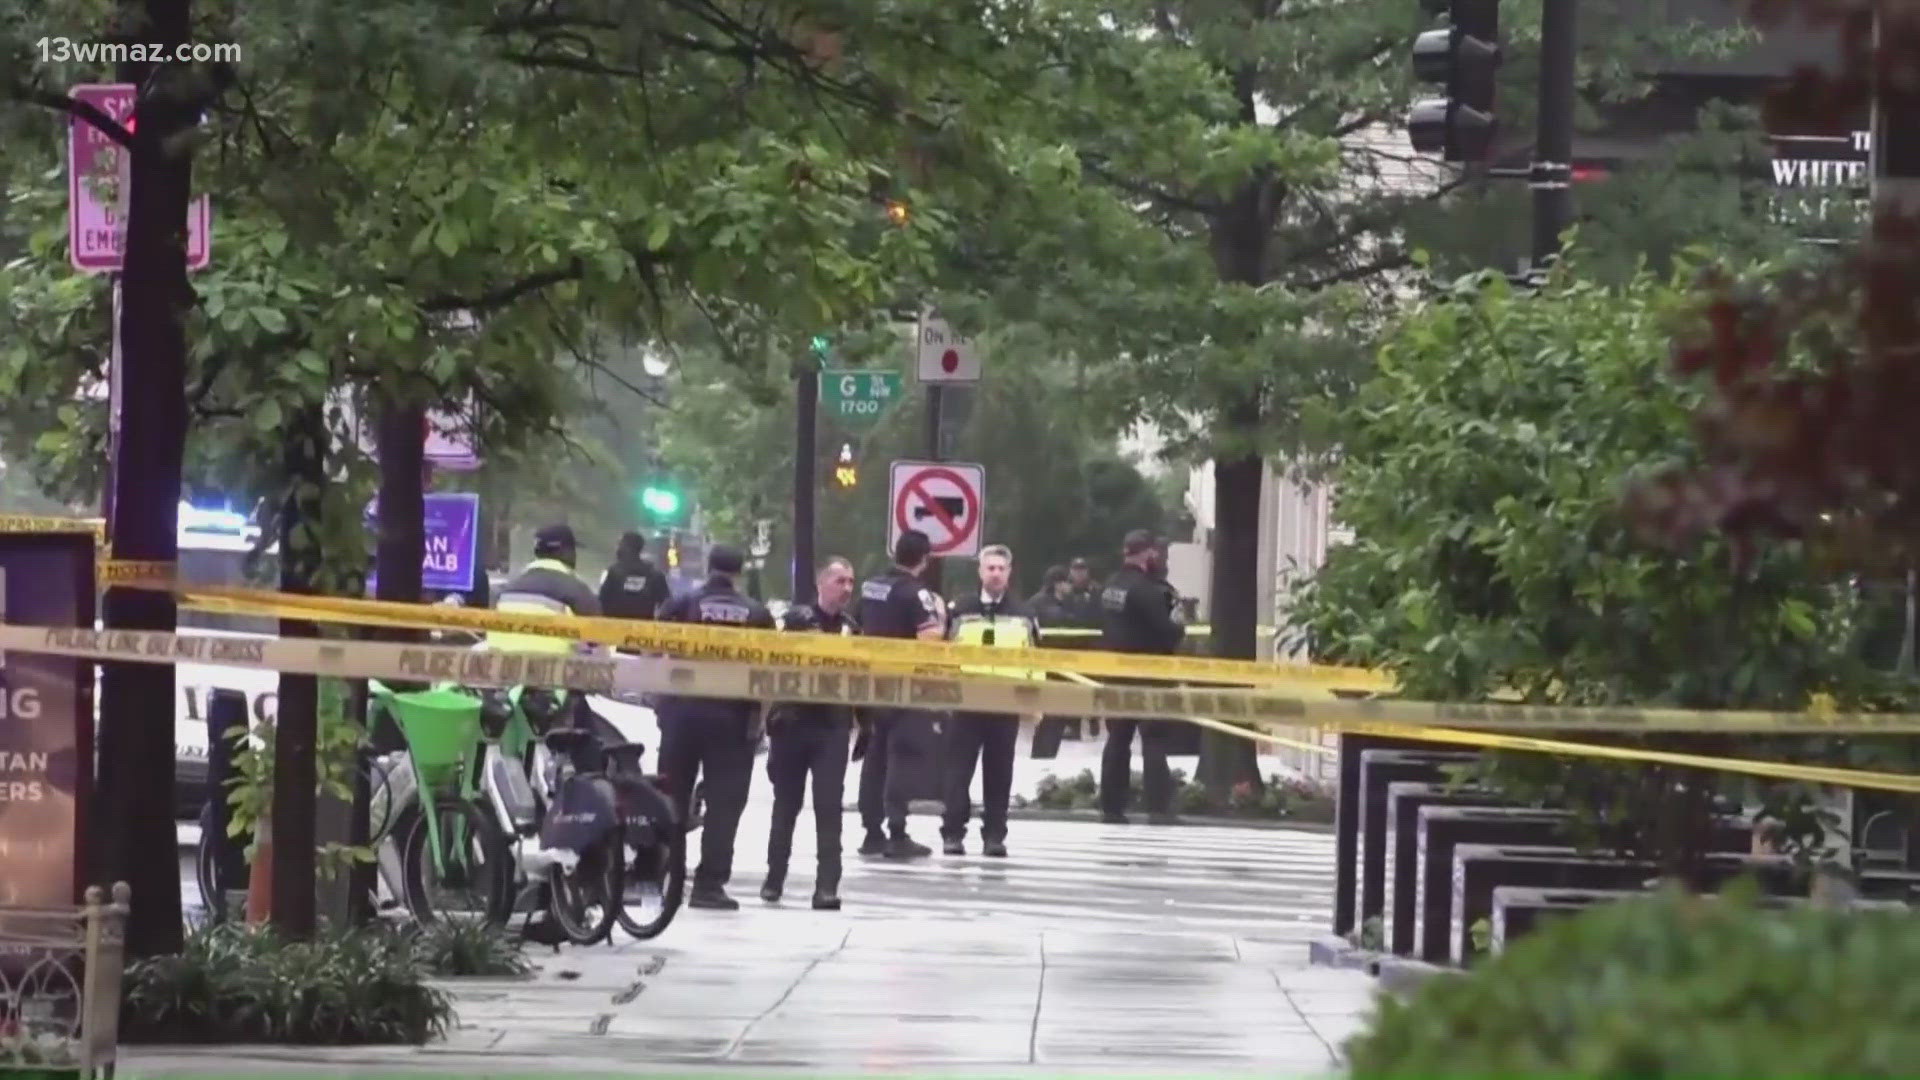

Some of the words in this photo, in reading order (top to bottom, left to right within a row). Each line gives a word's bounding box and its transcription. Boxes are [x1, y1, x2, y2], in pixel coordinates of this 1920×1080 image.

[1771, 159, 1866, 187] WHITE
[840, 375, 857, 397] G
[840, 401, 878, 413] 1700
[400, 649, 457, 677] POLICE
[461, 651, 495, 679] LINE
[624, 634, 690, 651] POLICE
[693, 644, 729, 660] LINE
[737, 648, 763, 662] DO
[769, 651, 803, 665] NOT
[808, 655, 870, 669] CROSS
